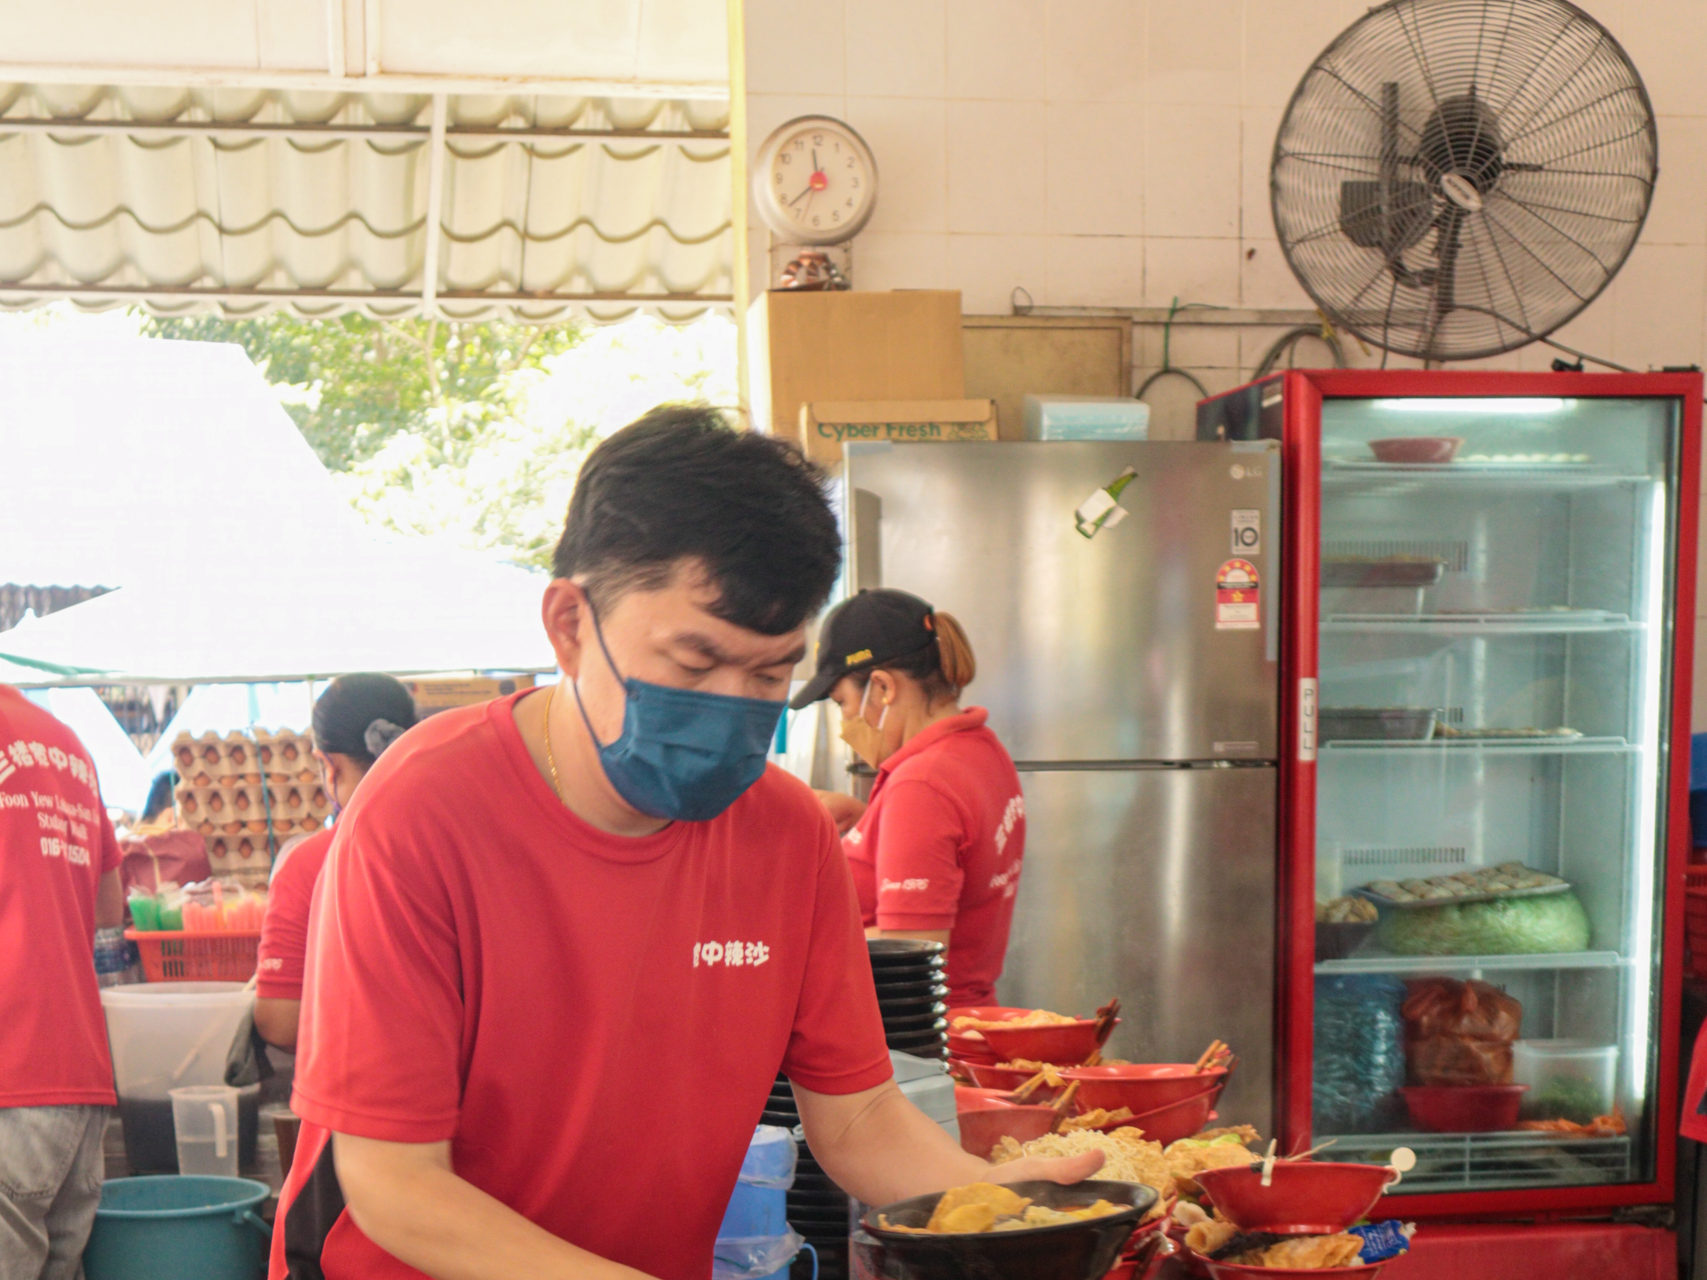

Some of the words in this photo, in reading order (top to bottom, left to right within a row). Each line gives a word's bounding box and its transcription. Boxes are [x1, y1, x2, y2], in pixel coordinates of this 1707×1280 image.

[794, 140, 804, 150] 11
[812, 134, 823, 146] 12
[834, 142, 840, 152] 1
[780, 153, 791, 165] 10
[846, 157, 855, 168] 2
[775, 173, 783, 184] 9
[852, 177, 859, 188] 3
[780, 193, 788, 204] 8
[846, 196, 853, 207] 4
[794, 207, 802, 218] 7
[832, 210, 840, 222] 5
[812, 215, 820, 226] 6
[817, 423, 880, 441] Cyber
[885, 423, 942, 437] Fresh
[1233, 527, 1258, 547] 10
[1304, 688, 1314, 751] PULL
